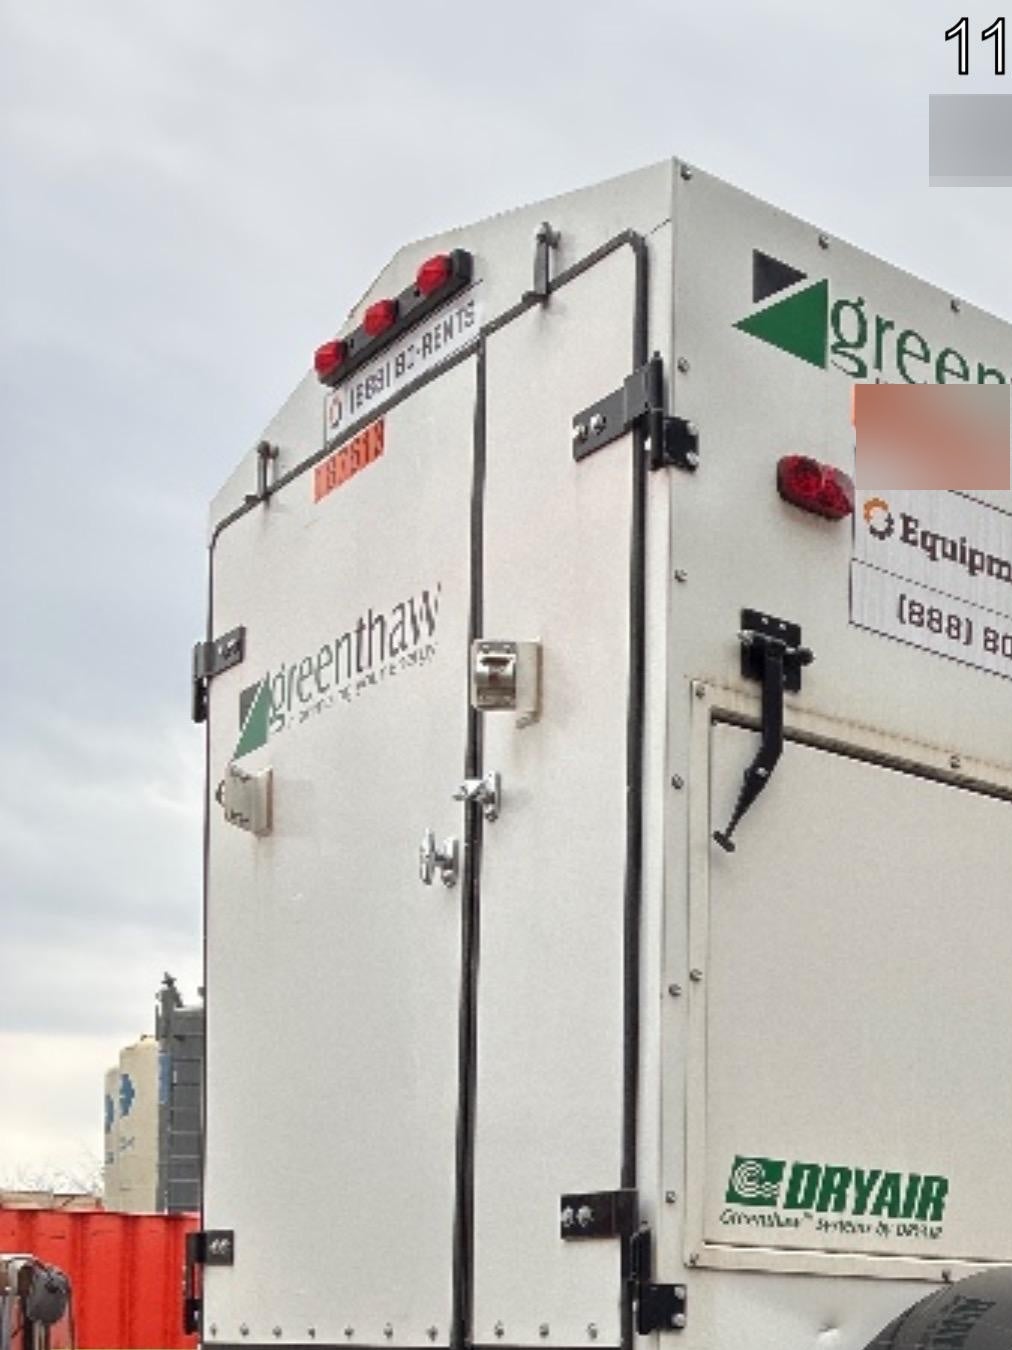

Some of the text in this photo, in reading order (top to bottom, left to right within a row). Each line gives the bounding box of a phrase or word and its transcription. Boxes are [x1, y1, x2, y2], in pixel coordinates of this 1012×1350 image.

[897, 593, 974, 647] (888)
[269, 581, 442, 733] greenthaw
[783, 1161, 949, 1222] DRYAIR
